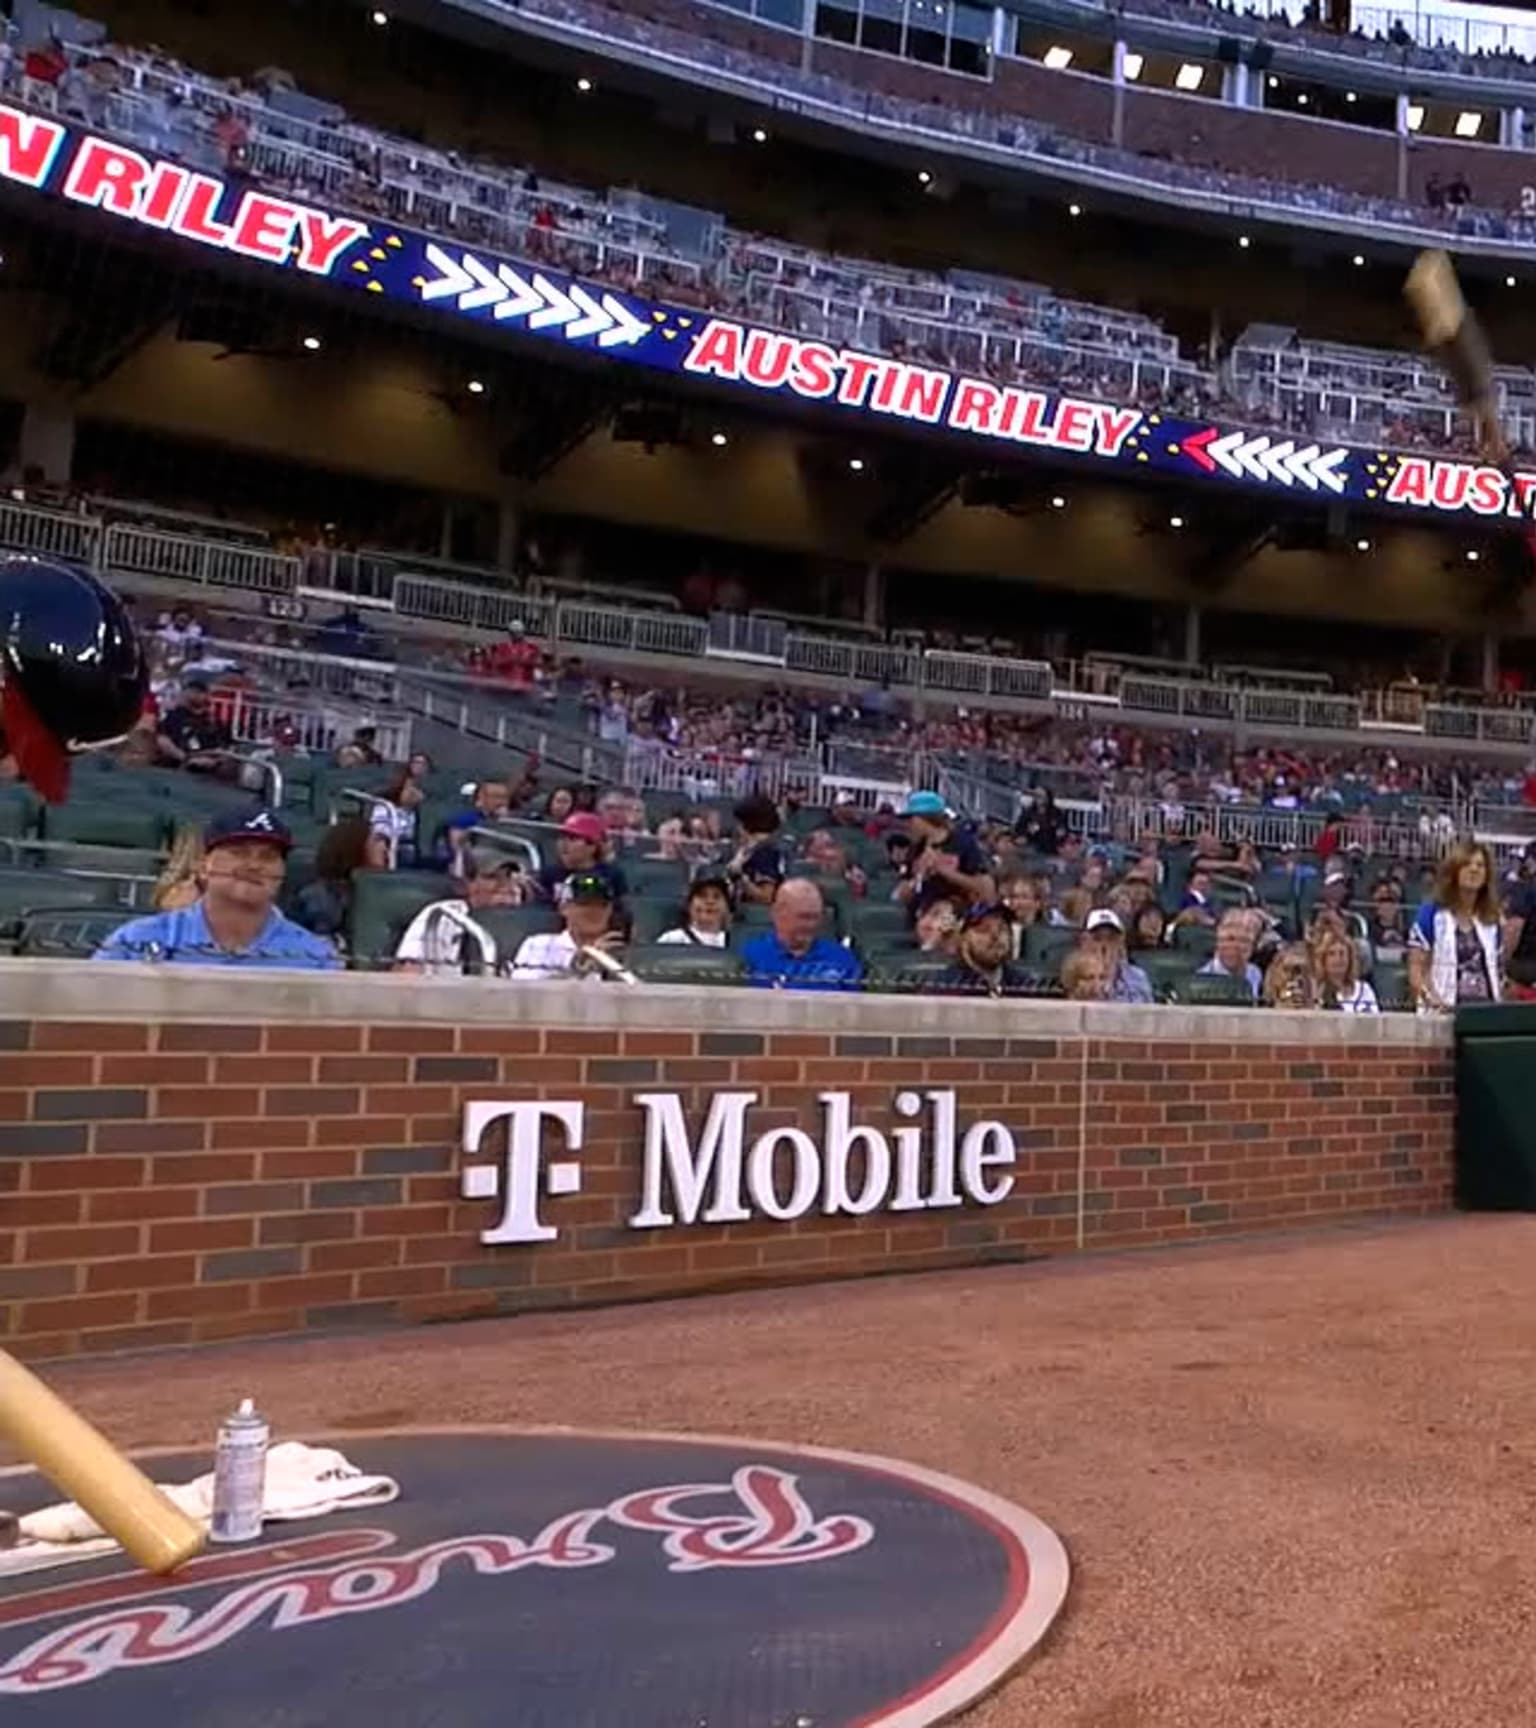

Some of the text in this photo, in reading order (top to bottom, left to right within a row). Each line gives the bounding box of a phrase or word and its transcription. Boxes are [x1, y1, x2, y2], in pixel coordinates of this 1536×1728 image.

[64, 135, 372, 274] RILEY
[686, 319, 1141, 457] AUSTIN RILEY
[629, 1090, 1018, 1228] Mobile
